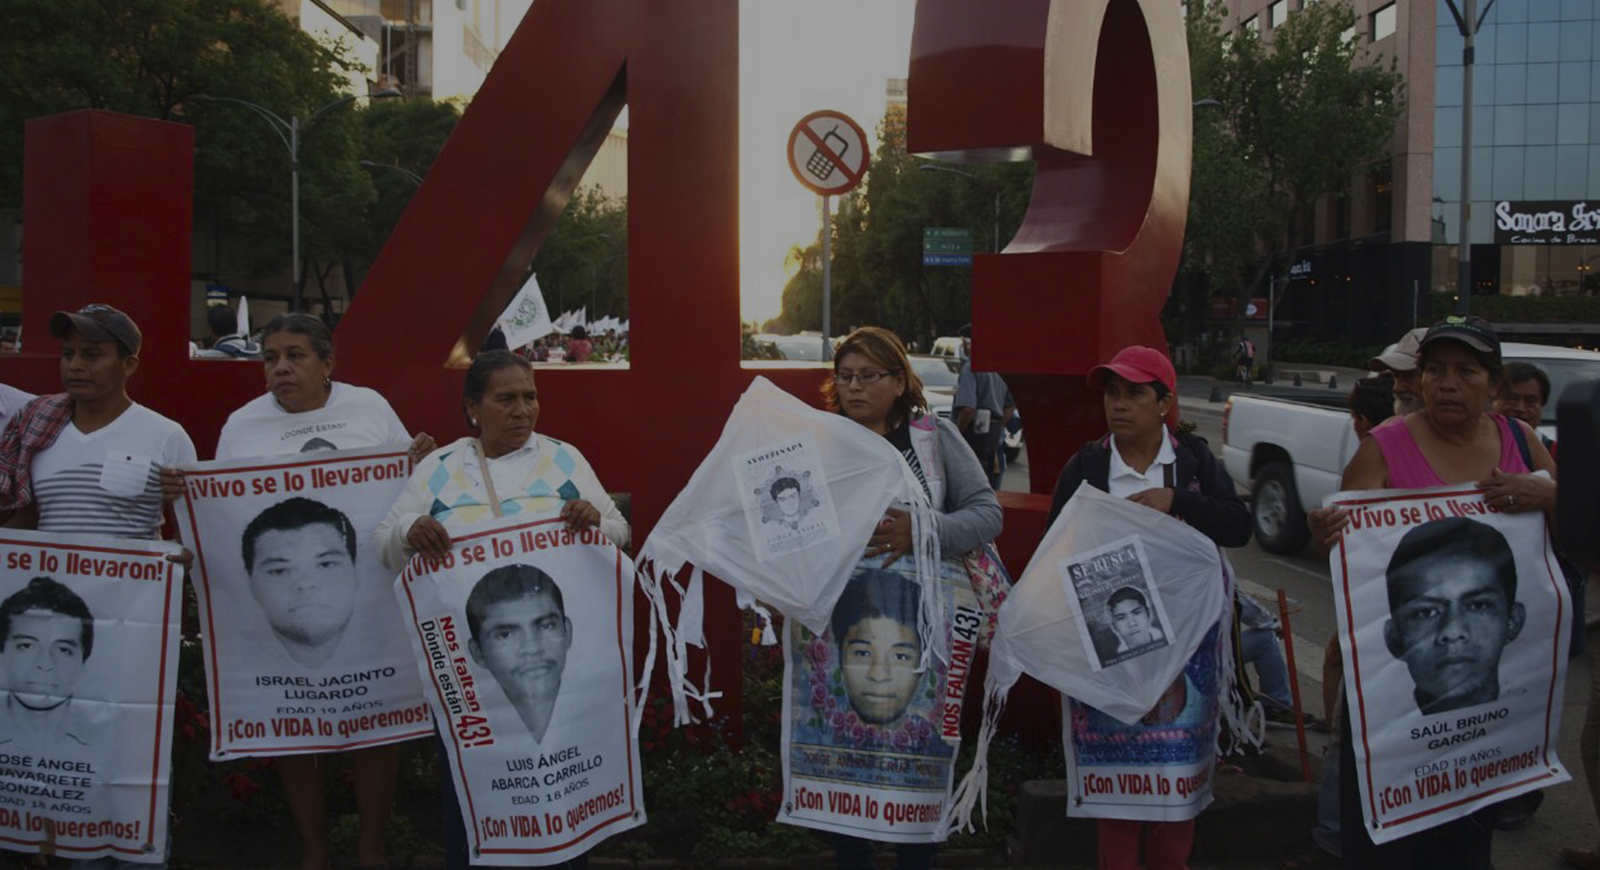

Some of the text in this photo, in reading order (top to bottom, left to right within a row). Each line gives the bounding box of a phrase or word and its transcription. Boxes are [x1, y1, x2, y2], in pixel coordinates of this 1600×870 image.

[1495, 201, 1566, 233] Sonora
[190, 459, 404, 500] ¡Vivo se lo llevaron!
[1400, 508, 1421, 526] se
[1424, 502, 1445, 523] lo
[1446, 499, 1504, 517] lleva
[461, 544, 486, 566] se
[491, 537, 514, 559] lo
[520, 527, 613, 553] llevaron
[7, 550, 163, 581] se lo llevaron!
[1072, 564, 1091, 581] SE
[1093, 548, 1136, 573] BUSCA
[256, 666, 396, 688] ISRAEL JACINTO
[421, 620, 463, 714] Dónde están
[440, 616, 494, 748] Nos faltan 43!
[943, 606, 983, 737] NOS FALTAN 43!
[277, 706, 315, 715] EDAD
[342, 700, 383, 714] AÑOS
[285, 685, 368, 700] LUGARDO
[228, 703, 429, 742] ¡Con VIDA lo queremos!
[1410, 708, 1509, 741] SAÚL BRUNO
[1428, 727, 1487, 750] GARCÍA
[0, 754, 95, 774] OSÉ ÁNGEL
[491, 755, 603, 791] ABARCA CARRILLO
[506, 746, 581, 772] LUIS ÁNGEL
[1415, 746, 1503, 778] EDAD 18 AÑOS
[512, 778, 589, 805] EDAD 18 AÑOS
[1084, 774, 1113, 796] ¡Con
[1117, 774, 1153, 795] VIDA
[1157, 774, 1170, 795] lo
[1379, 746, 1540, 815] ¡Con VIDA lo queremos!
[0, 795, 25, 807] DAD
[50, 803, 92, 814] AÑOS
[481, 783, 625, 841] ¡Con VIDA lo queremos!
[795, 787, 823, 811] ¡Con
[828, 790, 861, 817] VIDA
[865, 795, 878, 819] lo
[0, 808, 140, 841] DA lo ueremos!
